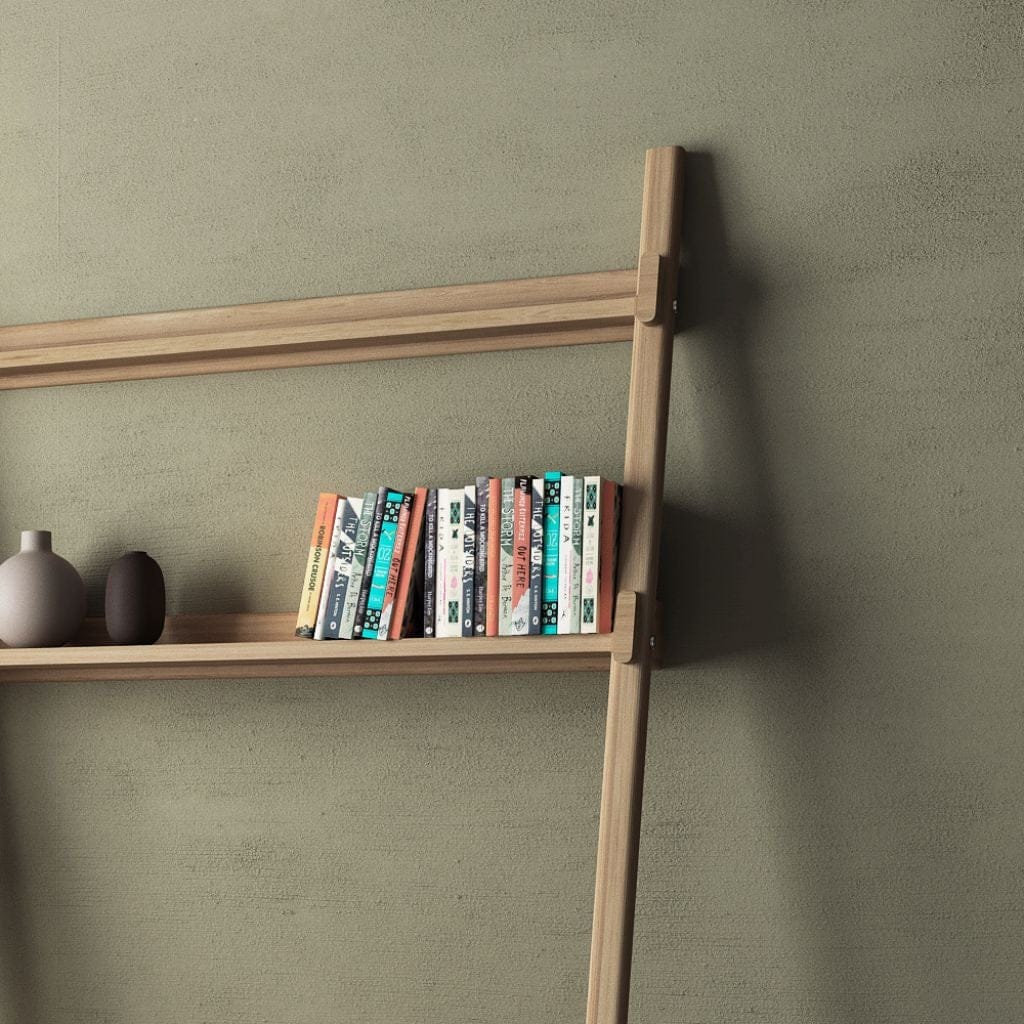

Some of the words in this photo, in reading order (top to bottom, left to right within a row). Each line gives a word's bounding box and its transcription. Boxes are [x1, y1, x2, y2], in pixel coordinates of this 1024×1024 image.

[503, 487, 514, 503] THE
[362, 502, 374, 518] THE
[465, 507, 476, 525] THE
[479, 504, 486, 512] TO
[533, 501, 543, 519] THE
[344, 517, 358, 535] THE
[428, 514, 434, 522] TO
[501, 508, 515, 546] STORM
[572, 508, 582, 545] STORM
[313, 525, 326, 563] ROBINSON
[353, 519, 372, 557] STORM
[478, 531, 486, 572] MOCKINGBIRD
[517, 546, 527, 562] OUT
[392, 557, 401, 572] OUT
[308, 564, 319, 591] CRUSOE
[516, 564, 526, 588] HERE
[386, 575, 397, 598] HERE
